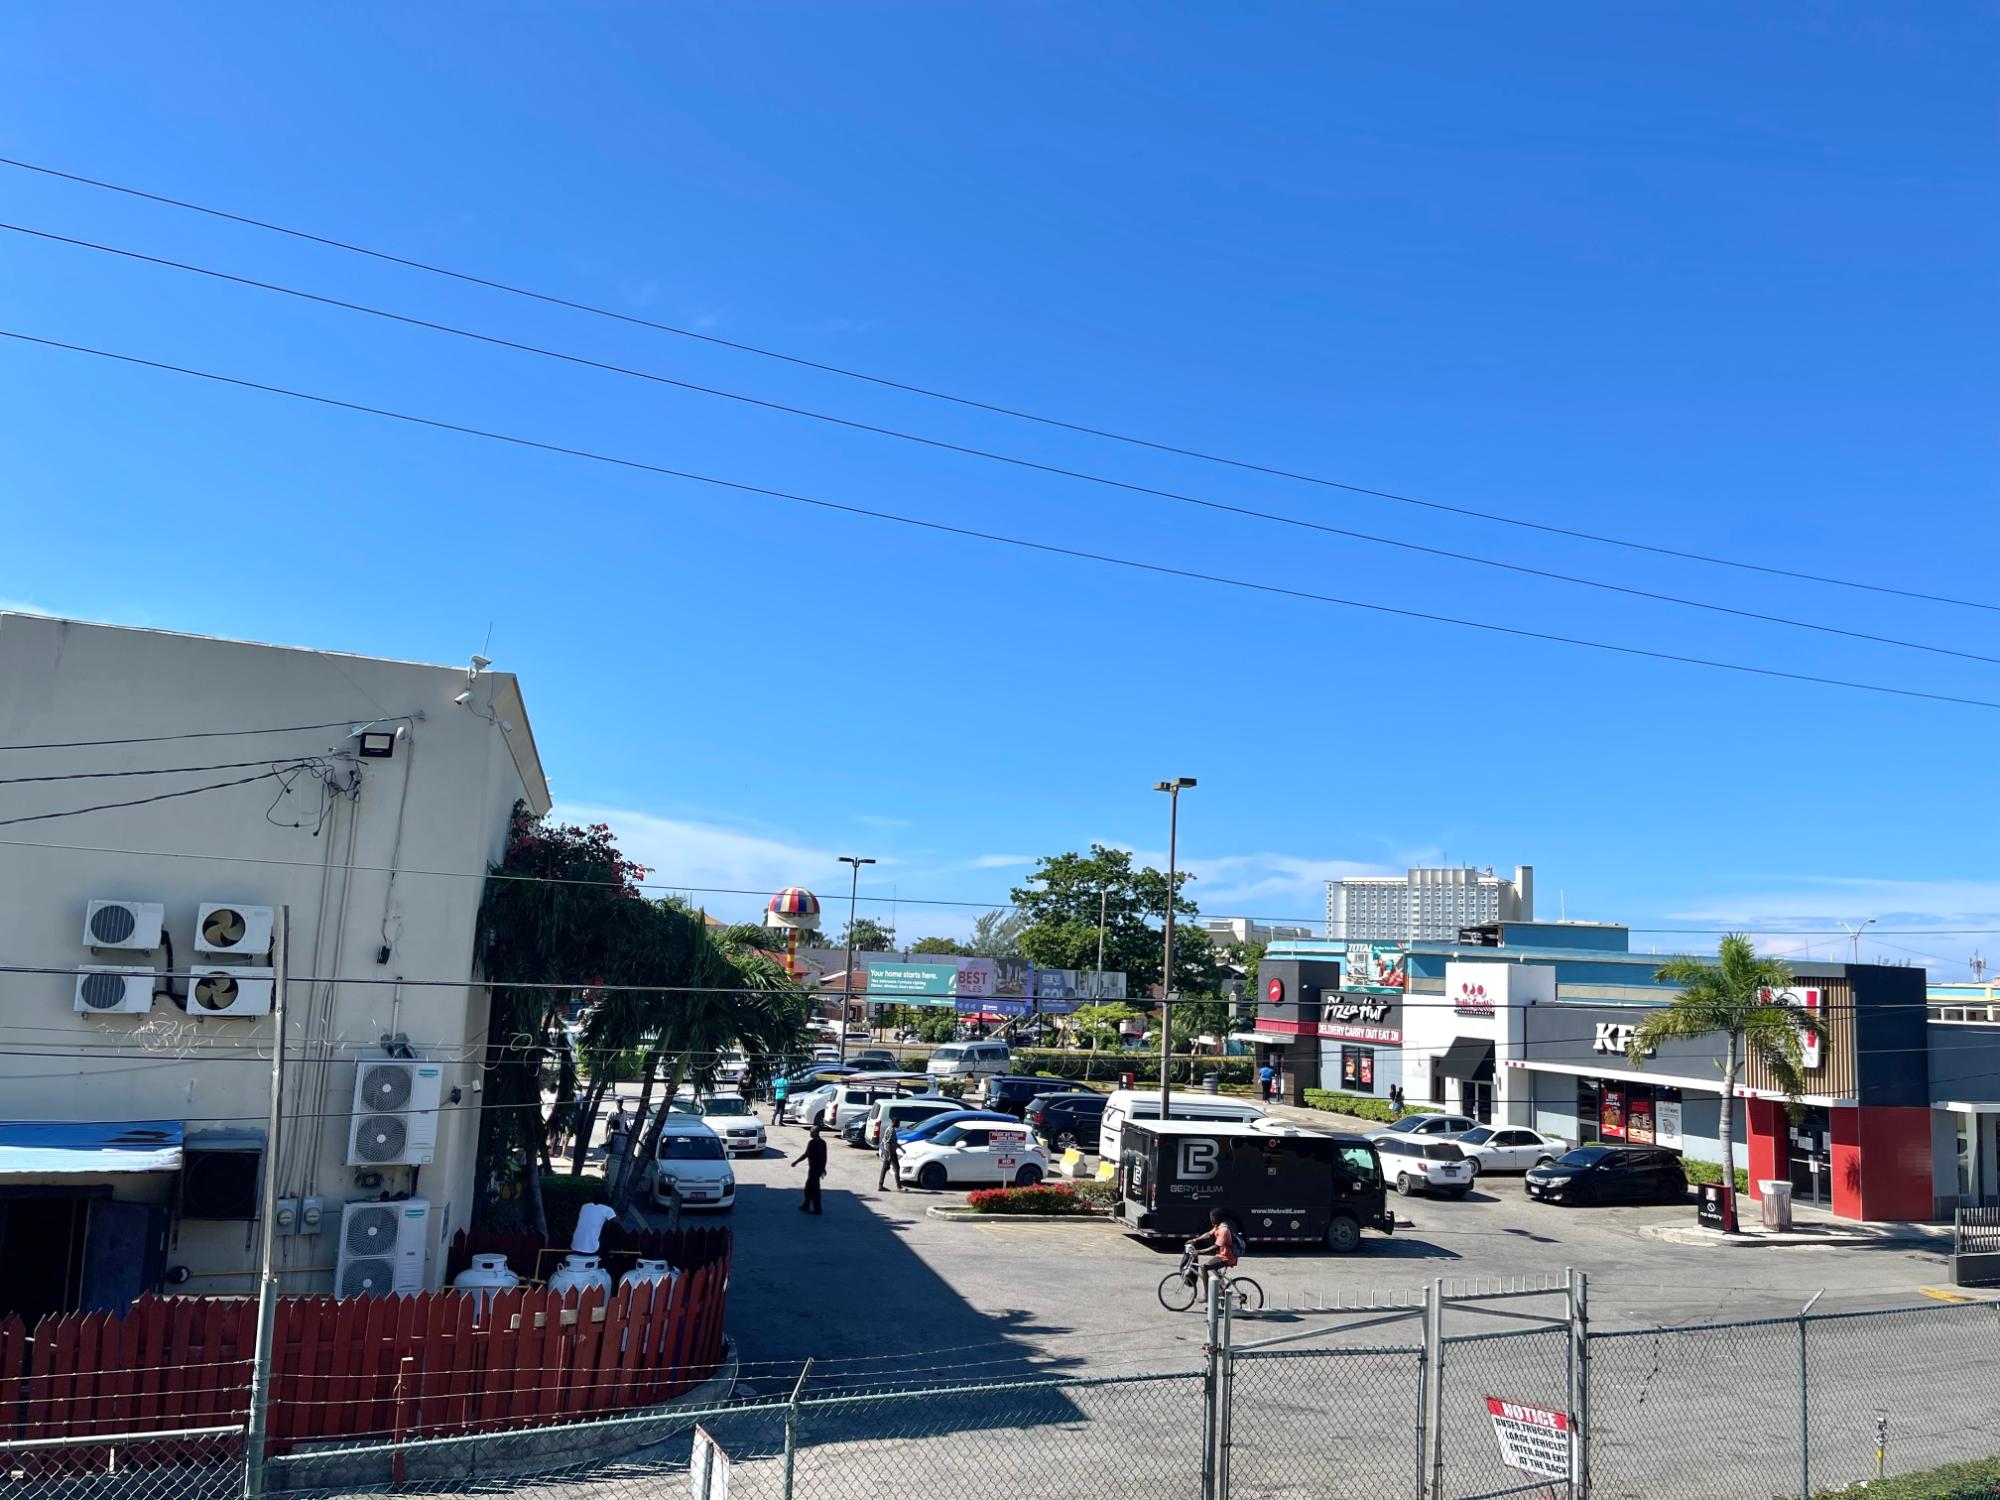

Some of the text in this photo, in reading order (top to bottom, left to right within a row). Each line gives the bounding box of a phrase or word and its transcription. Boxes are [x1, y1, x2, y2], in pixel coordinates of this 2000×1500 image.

[1348, 943, 1373, 952] TOTAL
[870, 969, 884, 977] Your
[885, 970, 902, 978] home
[958, 971, 988, 985] BEST
[961, 985, 982, 993] TILES
[1324, 995, 1387, 1020] Pizza Hut
[1319, 1024, 1399, 1041] DELIVERY CARRY OUT EAT IN
[1593, 1023, 1653, 1054] KF
[1170, 1184, 1223, 1193] BERYLLIUM
[1708, 1213, 1722, 1221] entry
[1502, 1402, 1558, 1428] NOTICE
[1505, 1431, 1568, 1452] LARGE VEHICLES
[1510, 1443, 1534, 1456] ENTER
[1535, 1448, 1552, 1461] AND
[1529, 1458, 1544, 1470] THE
[1545, 1462, 1567, 1475] BACK
